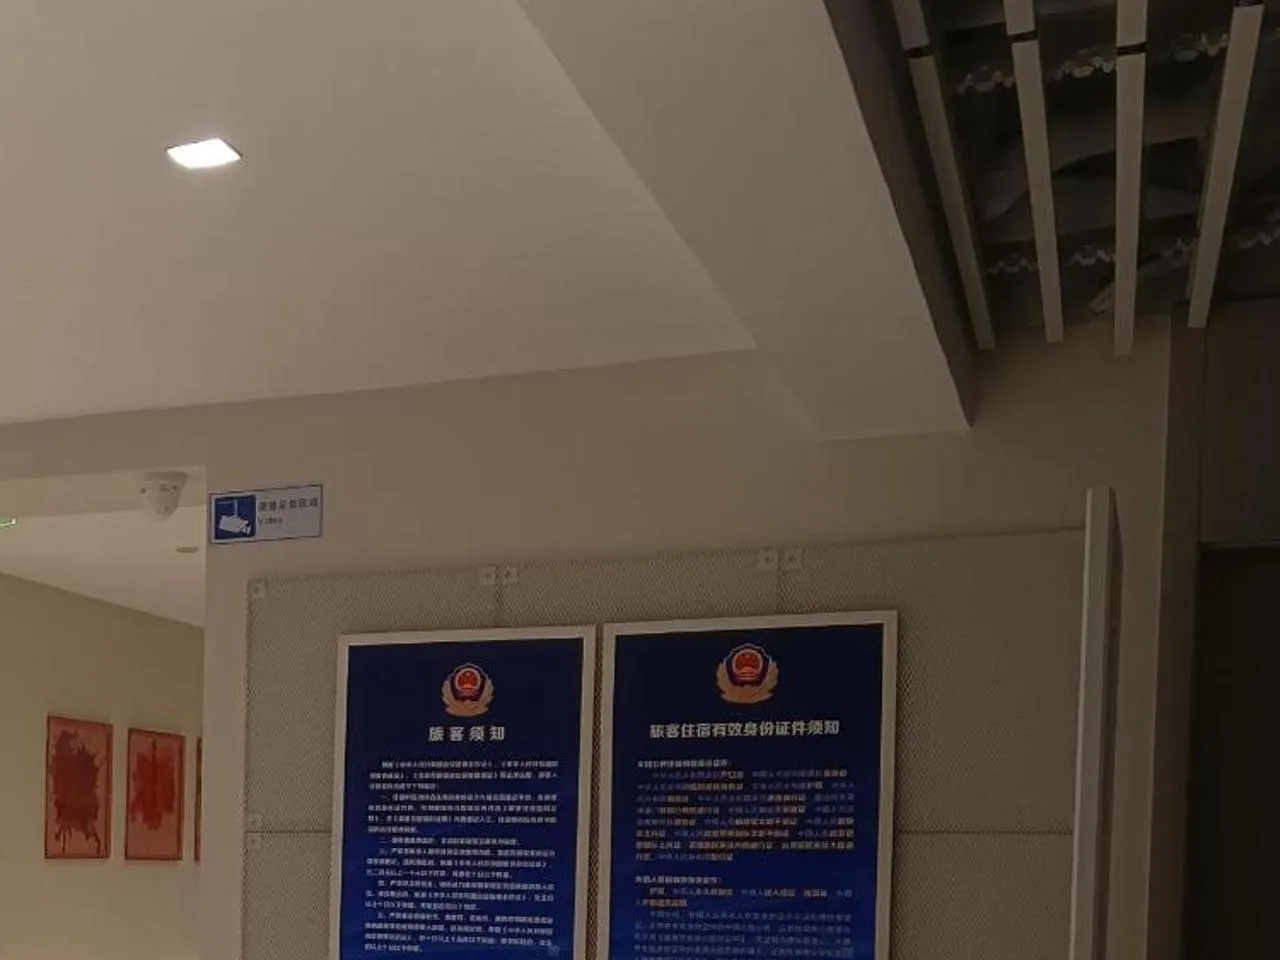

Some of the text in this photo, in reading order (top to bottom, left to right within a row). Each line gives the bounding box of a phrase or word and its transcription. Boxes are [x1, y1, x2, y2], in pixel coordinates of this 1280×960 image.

[428, 726, 506, 742] 旅客须知
[649, 719, 841, 739] 旅客住宿有效身份证件须知
